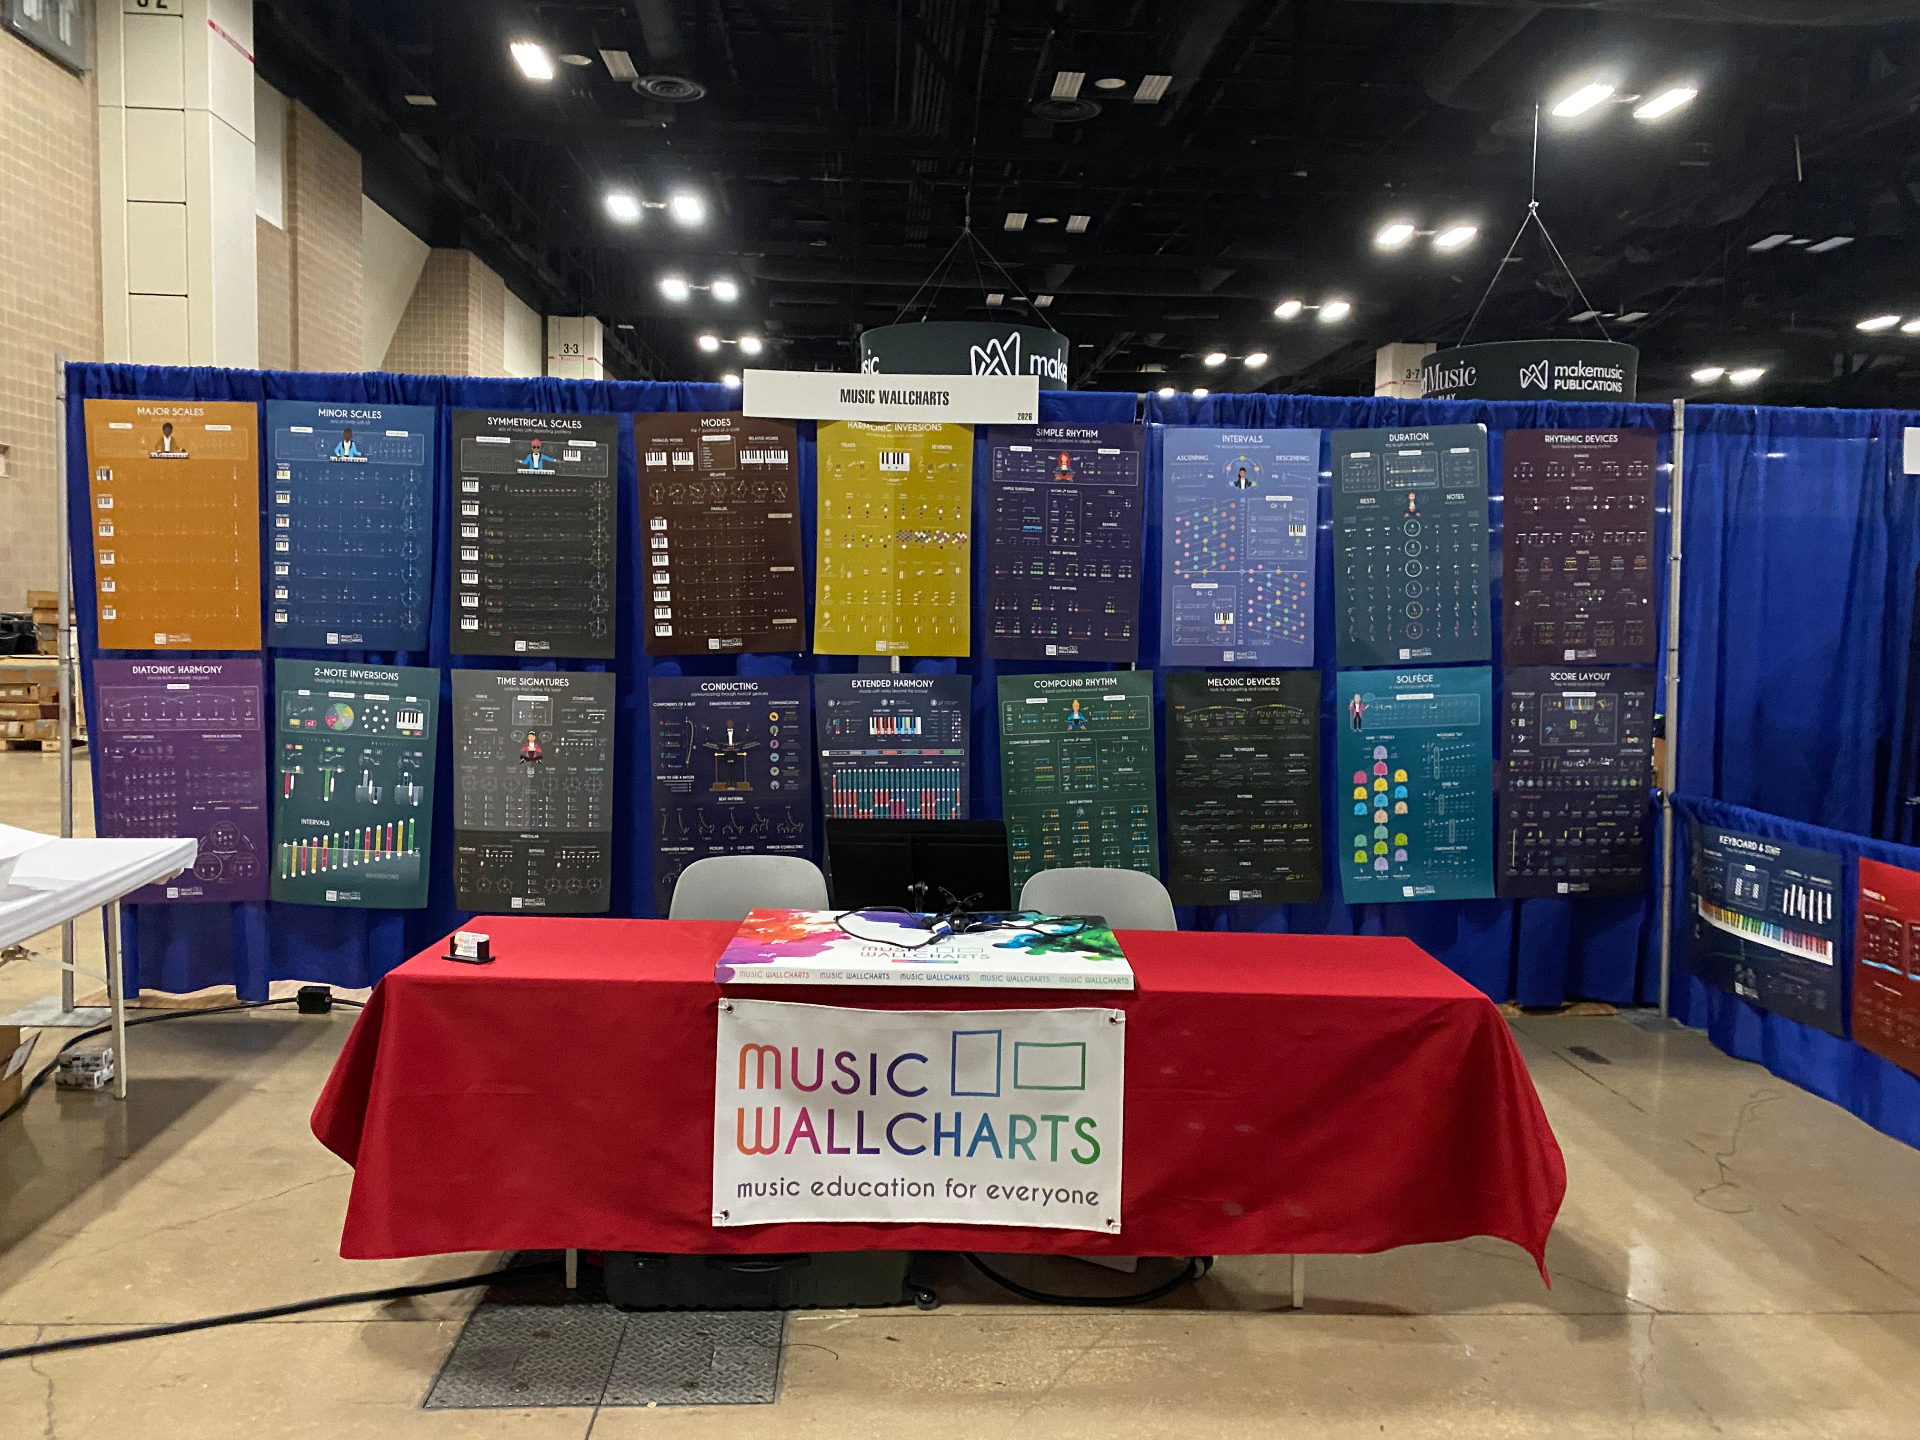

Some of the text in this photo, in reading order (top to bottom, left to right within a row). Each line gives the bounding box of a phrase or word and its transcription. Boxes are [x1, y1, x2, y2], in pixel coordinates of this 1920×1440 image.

[563, 343, 579, 354] 3-3
[1405, 369, 1420, 379] 3-7
[1554, 360, 1624, 380] makemusic
[1554, 379, 1622, 393] PUBLICATIONS
[840, 388, 950, 406] MUSIC WALLCHARTS
[137, 406, 205, 417] MAJOR SCALES
[318, 408, 382, 420] MINOR SCALES
[1017, 412, 1033, 421] 2026
[487, 416, 583, 429] SYMMETRICAL SCALES
[701, 418, 732, 427] MODES
[847, 422, 943, 433] HARMONIC INVERSIONS
[1036, 428, 1099, 438] SIMPLE RHYTHM
[1222, 434, 1264, 443] INTERVALS
[1389, 432, 1430, 442] DURATION
[1544, 434, 1619, 443] RHYTHMIC DEVICES
[132, 665, 223, 675] DIATONIC HARMONY
[314, 667, 400, 681] 2-NOTE INVERSIONS
[496, 676, 570, 687] TIME SIGNATURES
[1207, 677, 1281, 687] MELODIC DEVICES
[1550, 672, 1611, 681] SCORE LAYOUT
[700, 682, 759, 691] CONDUCTING
[851, 679, 935, 688] EXTENDED HARMONY
[1033, 677, 1118, 689] COMPOUND RHYTHM
[301, 818, 330, 827] INTERVALS
[1718, 835, 1758, 851] KEYBOARD
[861, 952, 990, 960] WALLCHARTS
[739, 970, 1130, 985] MUSIC WALLCHARTS MUSIC WALLCHARTS MUSIC WALLCHARTS MUSIC WALLCHARTS MUSIC WALLCHARTS
[738, 1043, 929, 1098] MUSIC
[736, 1106, 1101, 1165] WALLCHARTS
[737, 1175, 1100, 1207] music education for everyone
